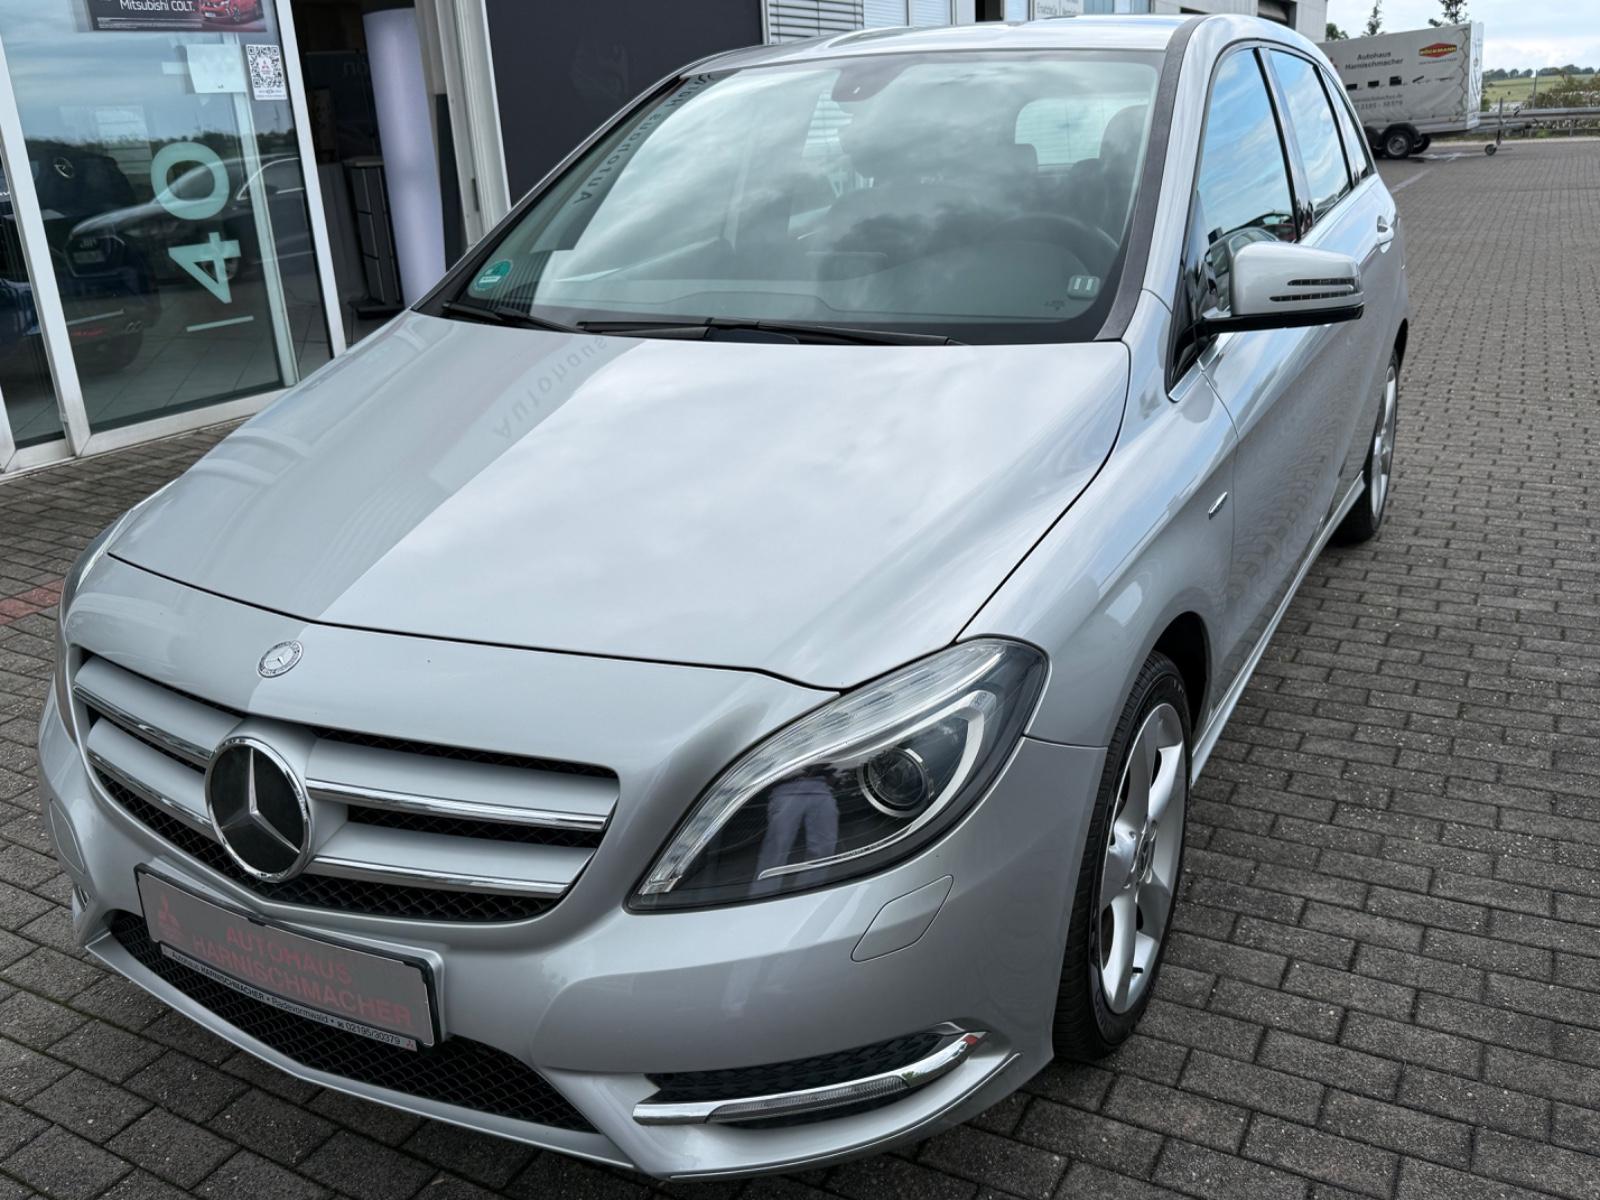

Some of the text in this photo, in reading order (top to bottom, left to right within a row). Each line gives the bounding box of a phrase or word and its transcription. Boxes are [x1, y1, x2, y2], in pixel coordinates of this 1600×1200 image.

[120, 0, 169, 11] Mitsubishi
[1357, 52, 1391, 60] Autohaus
[1345, 59, 1403, 69] Harnischmacher
[226, 926, 353, 985] AUTOHAUS
[192, 936, 414, 1027] HARNISCHMACHER
